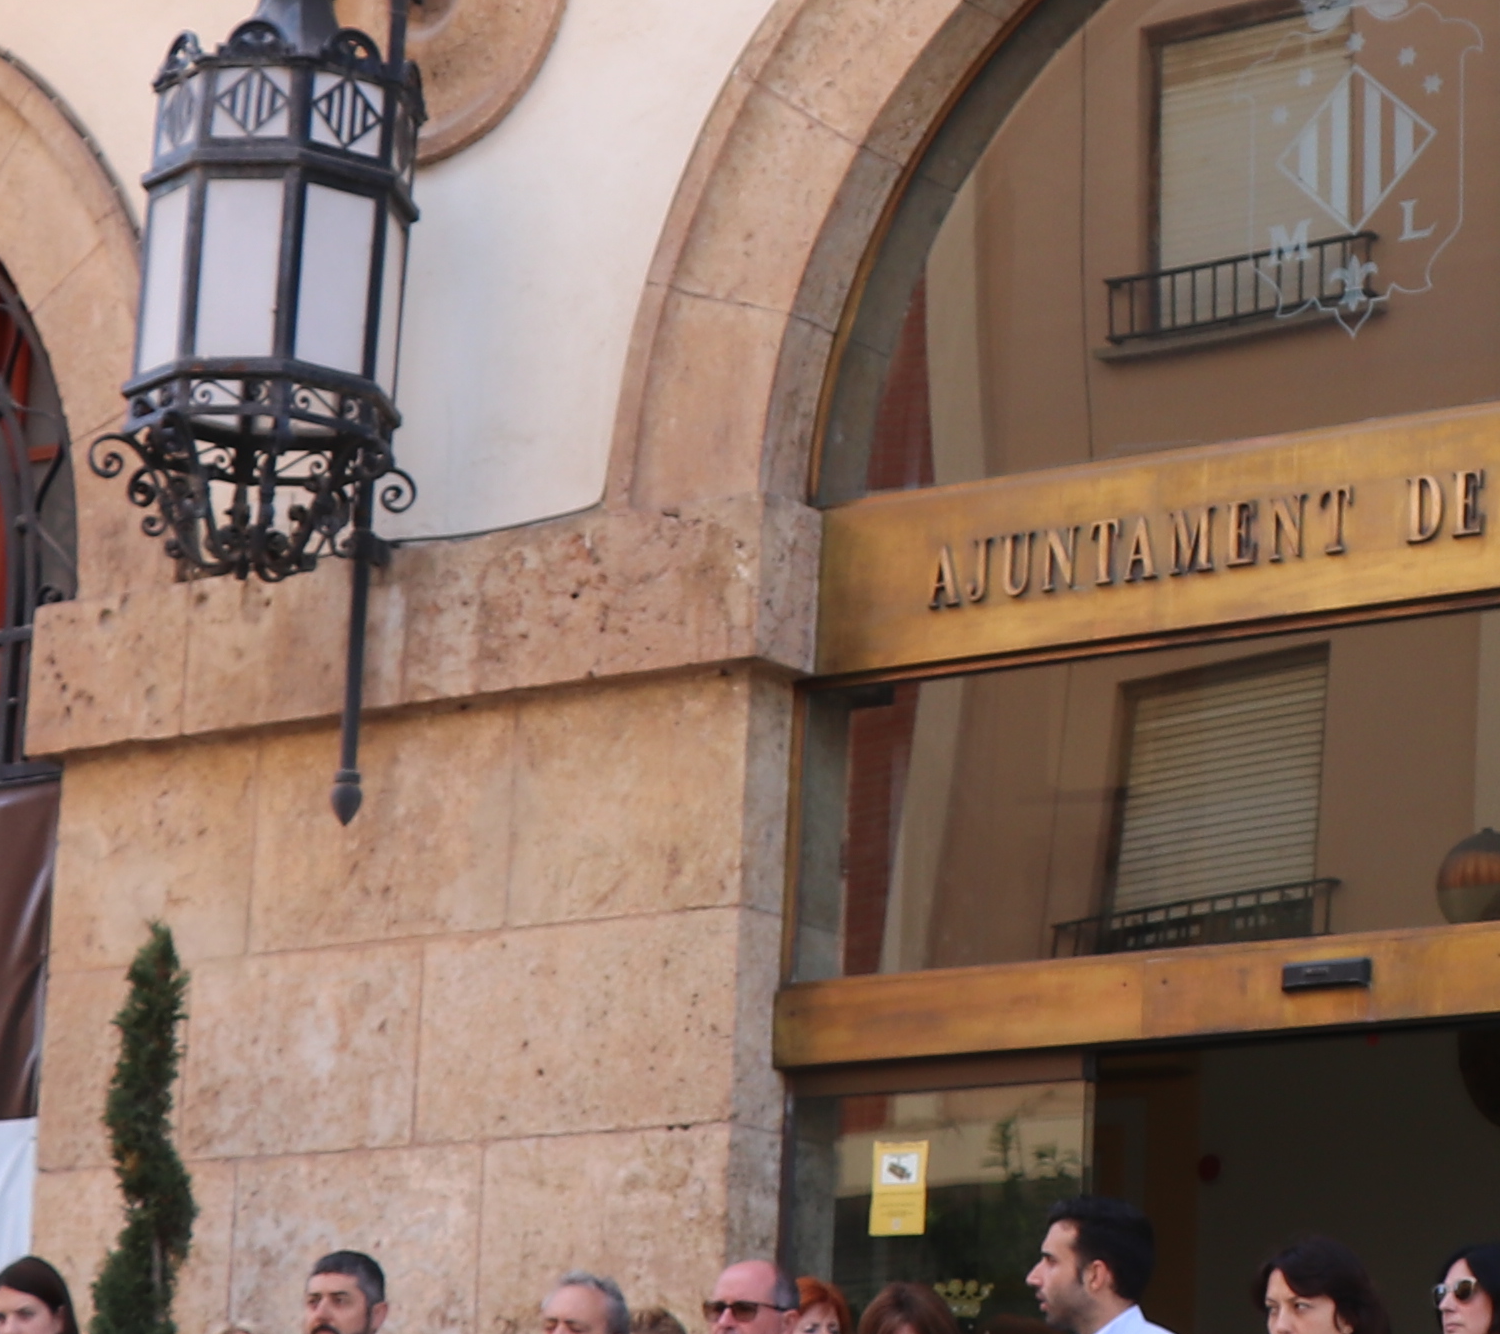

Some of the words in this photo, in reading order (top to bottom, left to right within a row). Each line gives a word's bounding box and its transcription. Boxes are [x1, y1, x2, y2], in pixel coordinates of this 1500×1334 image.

[1397, 198, 1438, 242] L
[928, 484, 1354, 610] AJUNTAMENT
[1405, 468, 1486, 546] DE
